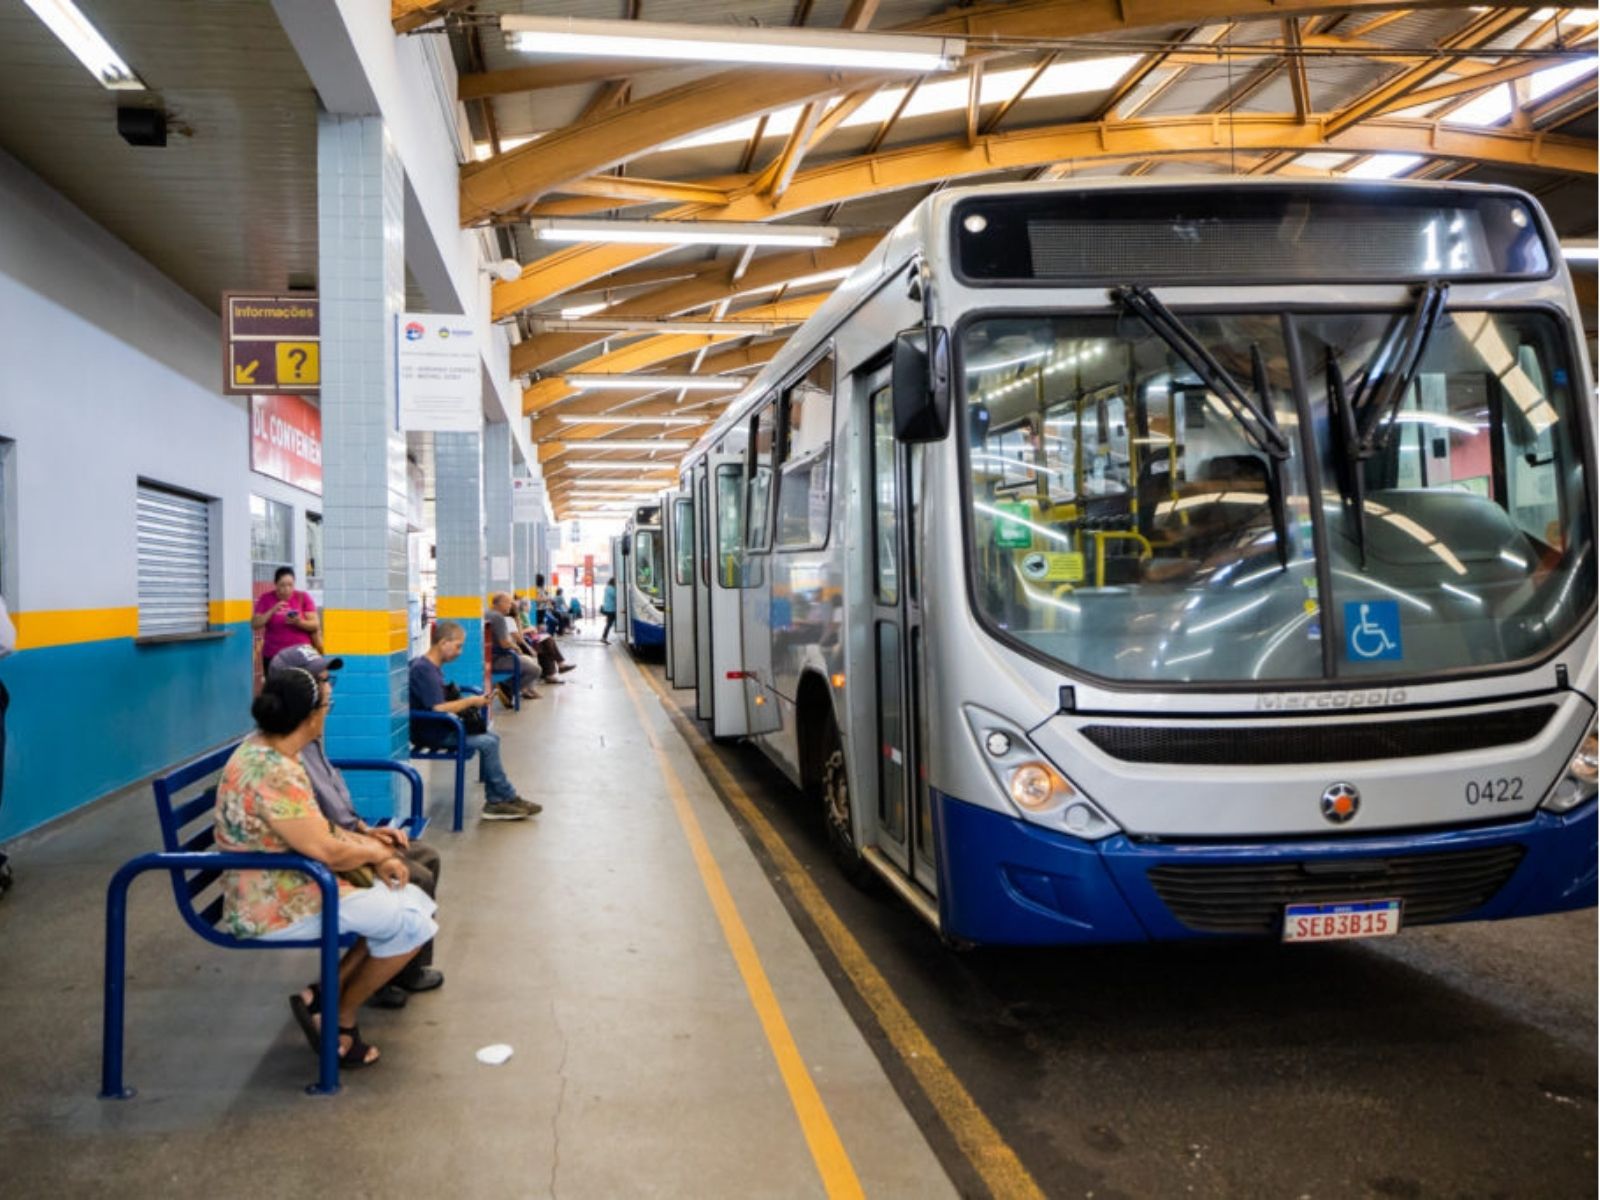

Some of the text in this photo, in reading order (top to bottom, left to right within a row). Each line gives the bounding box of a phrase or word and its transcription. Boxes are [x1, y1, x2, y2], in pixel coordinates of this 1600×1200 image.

[234, 305, 314, 319] Informações
[1465, 777, 1524, 805] 0422
[1296, 912, 1388, 938] SEB3B15
